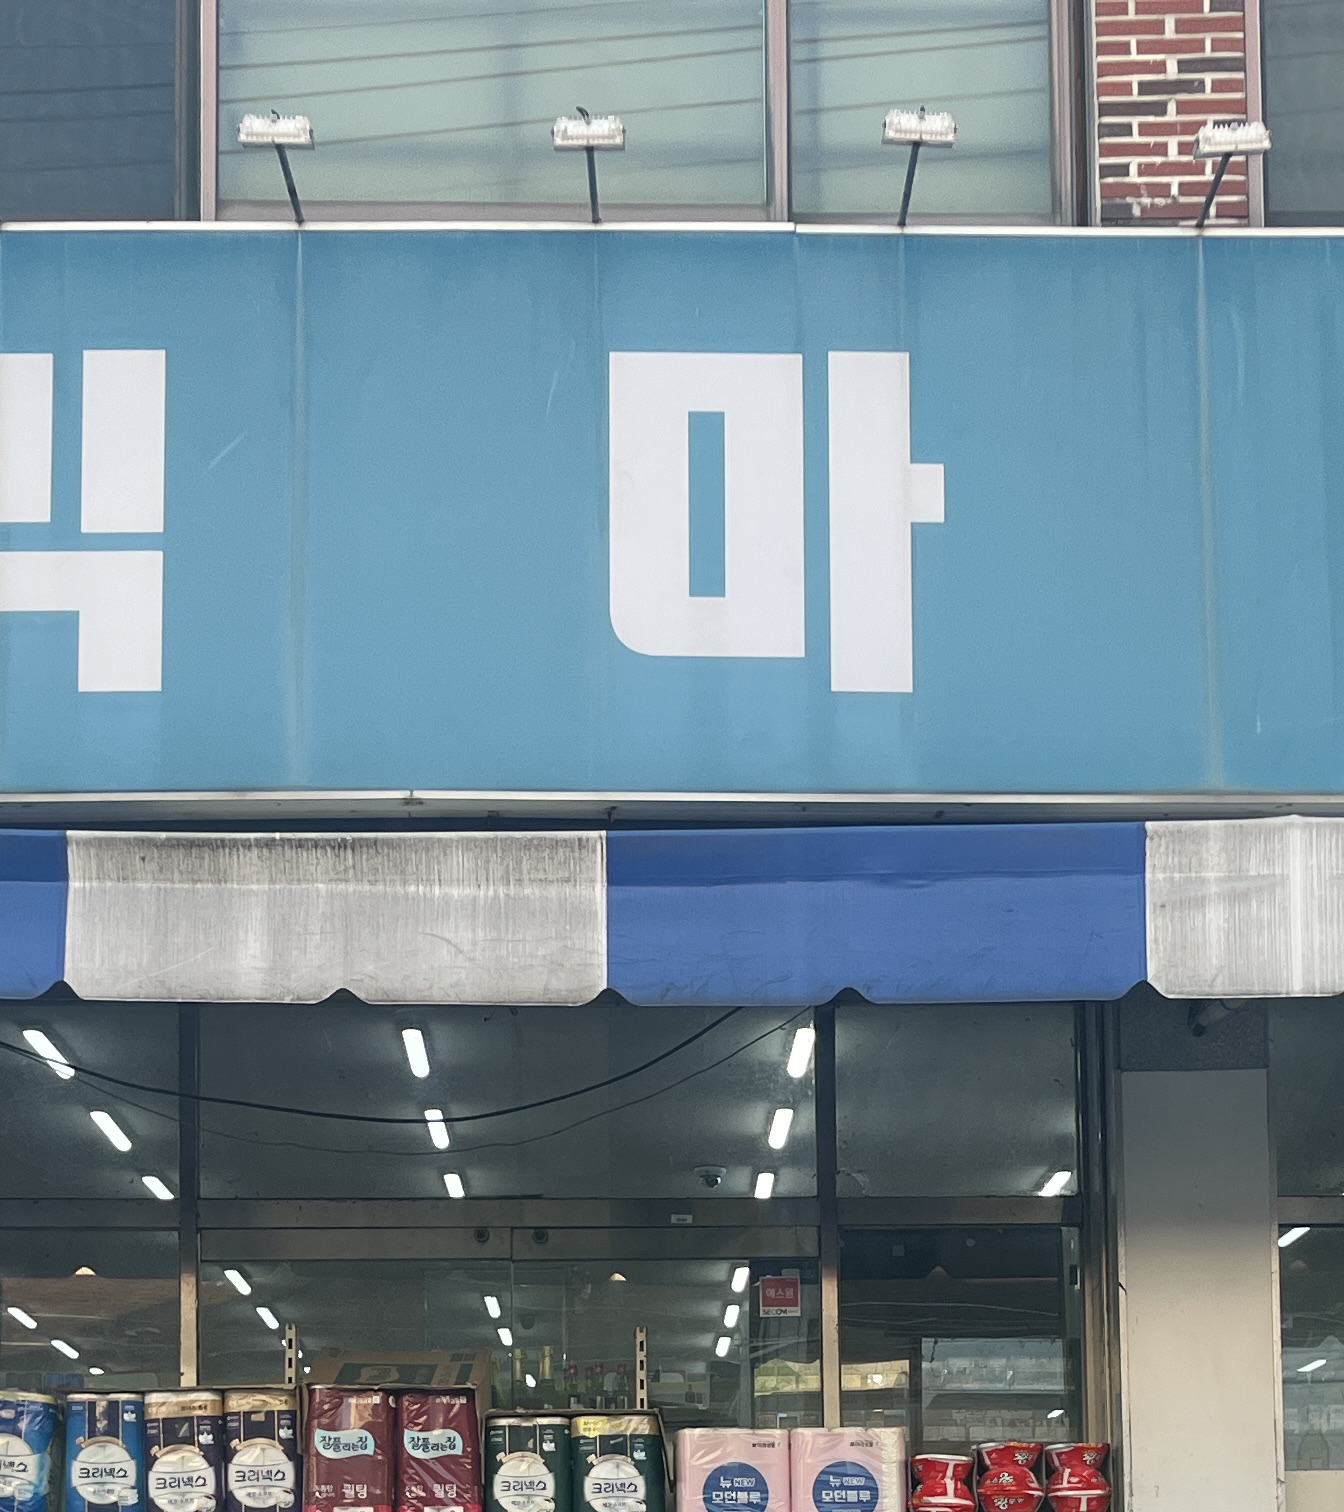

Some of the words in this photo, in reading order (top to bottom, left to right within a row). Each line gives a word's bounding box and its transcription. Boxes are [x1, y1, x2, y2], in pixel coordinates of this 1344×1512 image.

[762, 1308, 788, 1316] SECOM
[319, 1435, 368, 1451] 잘풀리는집
[407, 1435, 457, 1452] 잘풀리는집
[78, 1467, 129, 1479] 크리넥스
[234, 1469, 286, 1483] 크리넥스
[154, 1475, 208, 1490] 크리넥스
[499, 1480, 548, 1492] 크리넥스
[719, 1475, 732, 1488] 뉴
[733, 1477, 756, 1488] NEW
[829, 1475, 841, 1487] 뉴
[843, 1477, 866, 1487] NEW
[591, 1482, 639, 1494] 크리넥스
[712, 1491, 761, 1504] 모던블루
[821, 1490, 871, 1503] 모던블루
